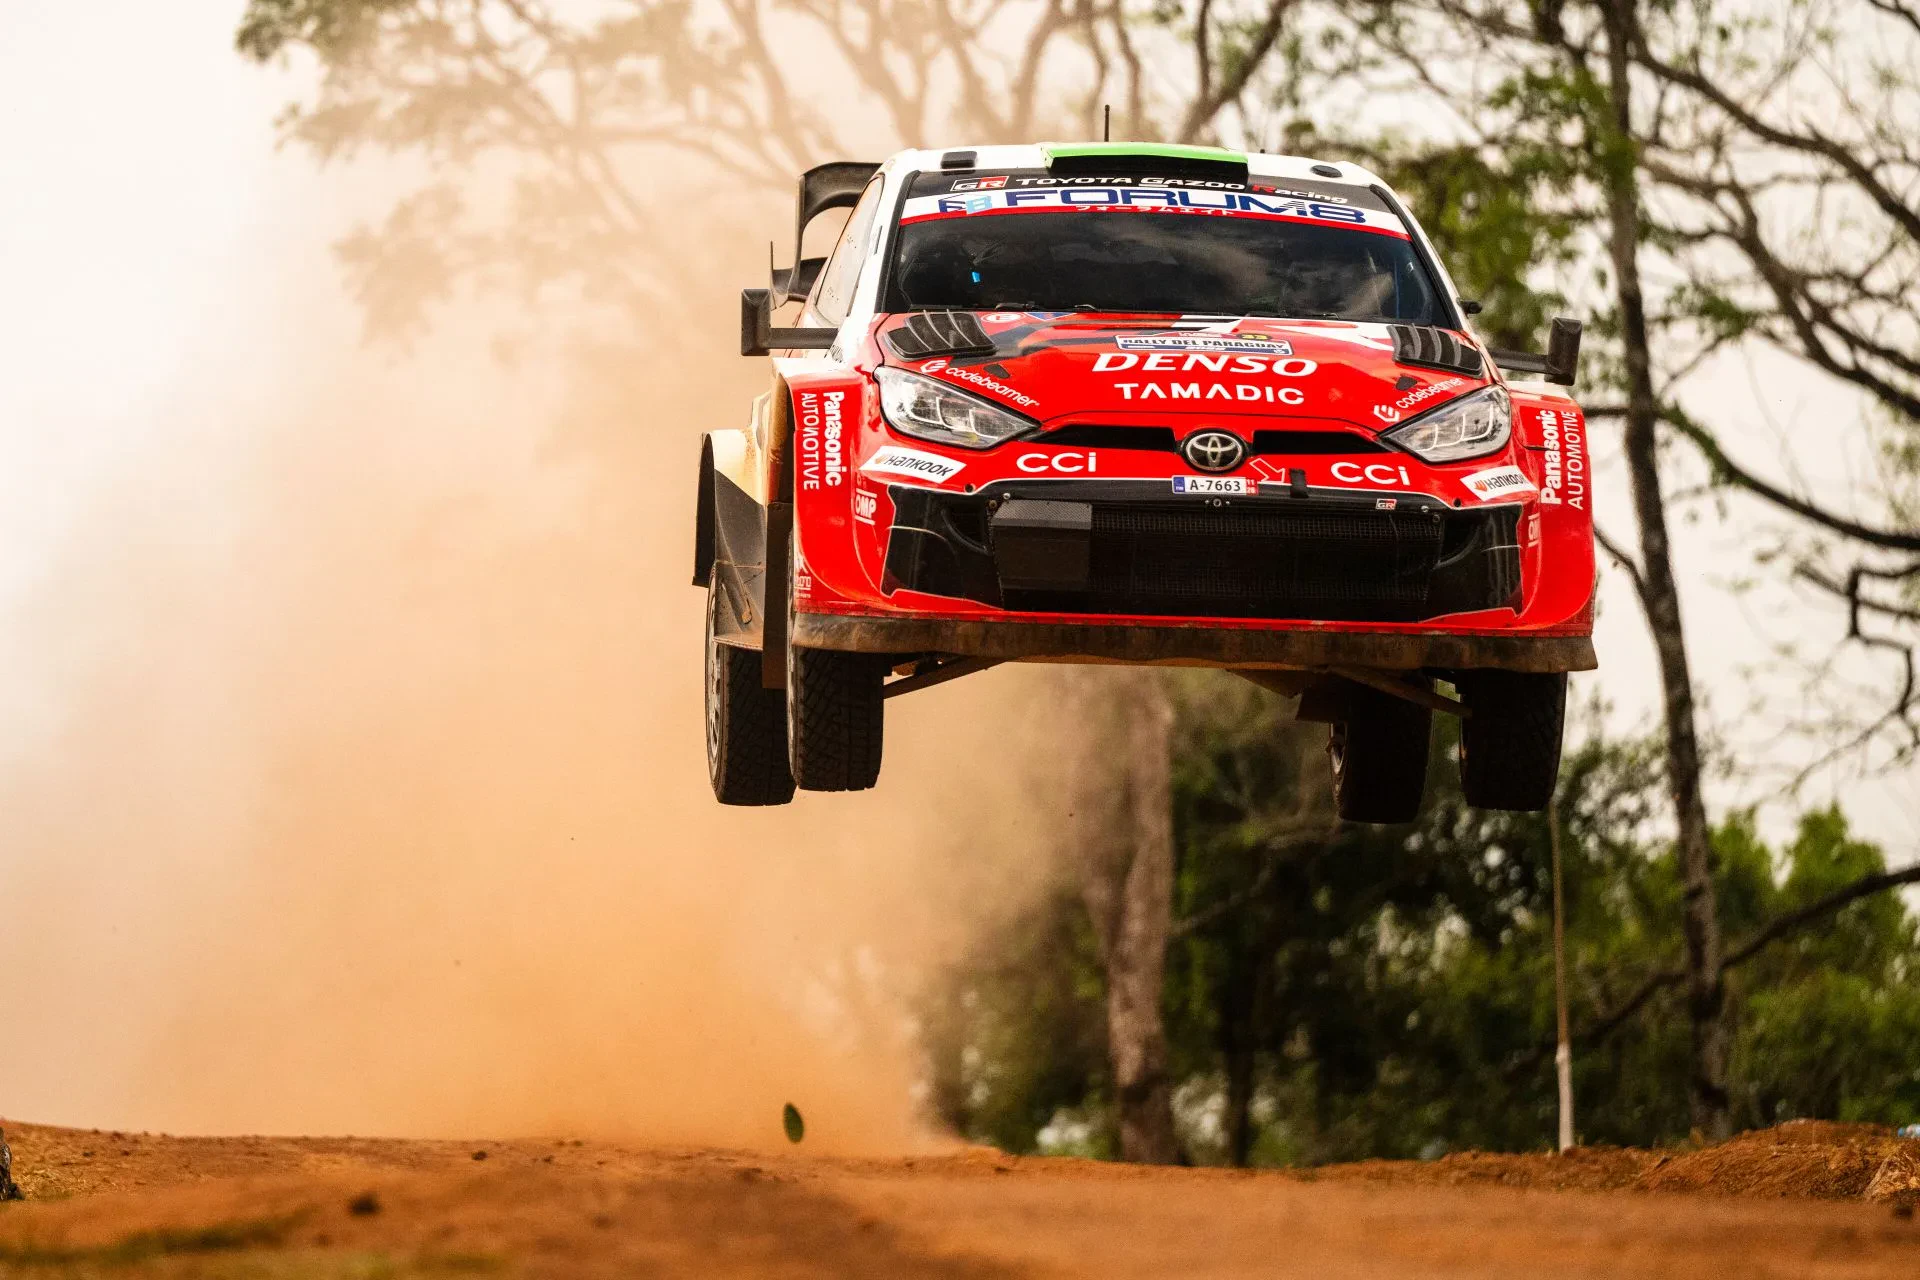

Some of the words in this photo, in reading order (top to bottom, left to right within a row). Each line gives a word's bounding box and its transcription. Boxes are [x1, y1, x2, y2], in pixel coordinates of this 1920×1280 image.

[952, 177, 1005, 191] GR
[1015, 177, 1133, 186] TOYOTA
[1138, 177, 1246, 190] GAZOO
[1250, 184, 1349, 204] Racing
[1005, 188, 1367, 224] FORUM8
[1075, 205, 1235, 216] フォーラムエイト
[1202, 340, 1285, 349] PARAGUAY
[1092, 353, 1318, 377] DENSO
[944, 366, 1040, 407] codebeamer
[1113, 383, 1305, 405] TAMADIC
[1395, 377, 1465, 409] codebeamer
[801, 392, 820, 491] AUTOMOTIVE
[823, 391, 848, 487] Panasonic
[1536, 410, 1562, 505] Panasonic
[1561, 411, 1584, 510] AUTOMOTIVE
[1189, 479, 1241, 492] A-7663
[855, 493, 877, 519] OMP
